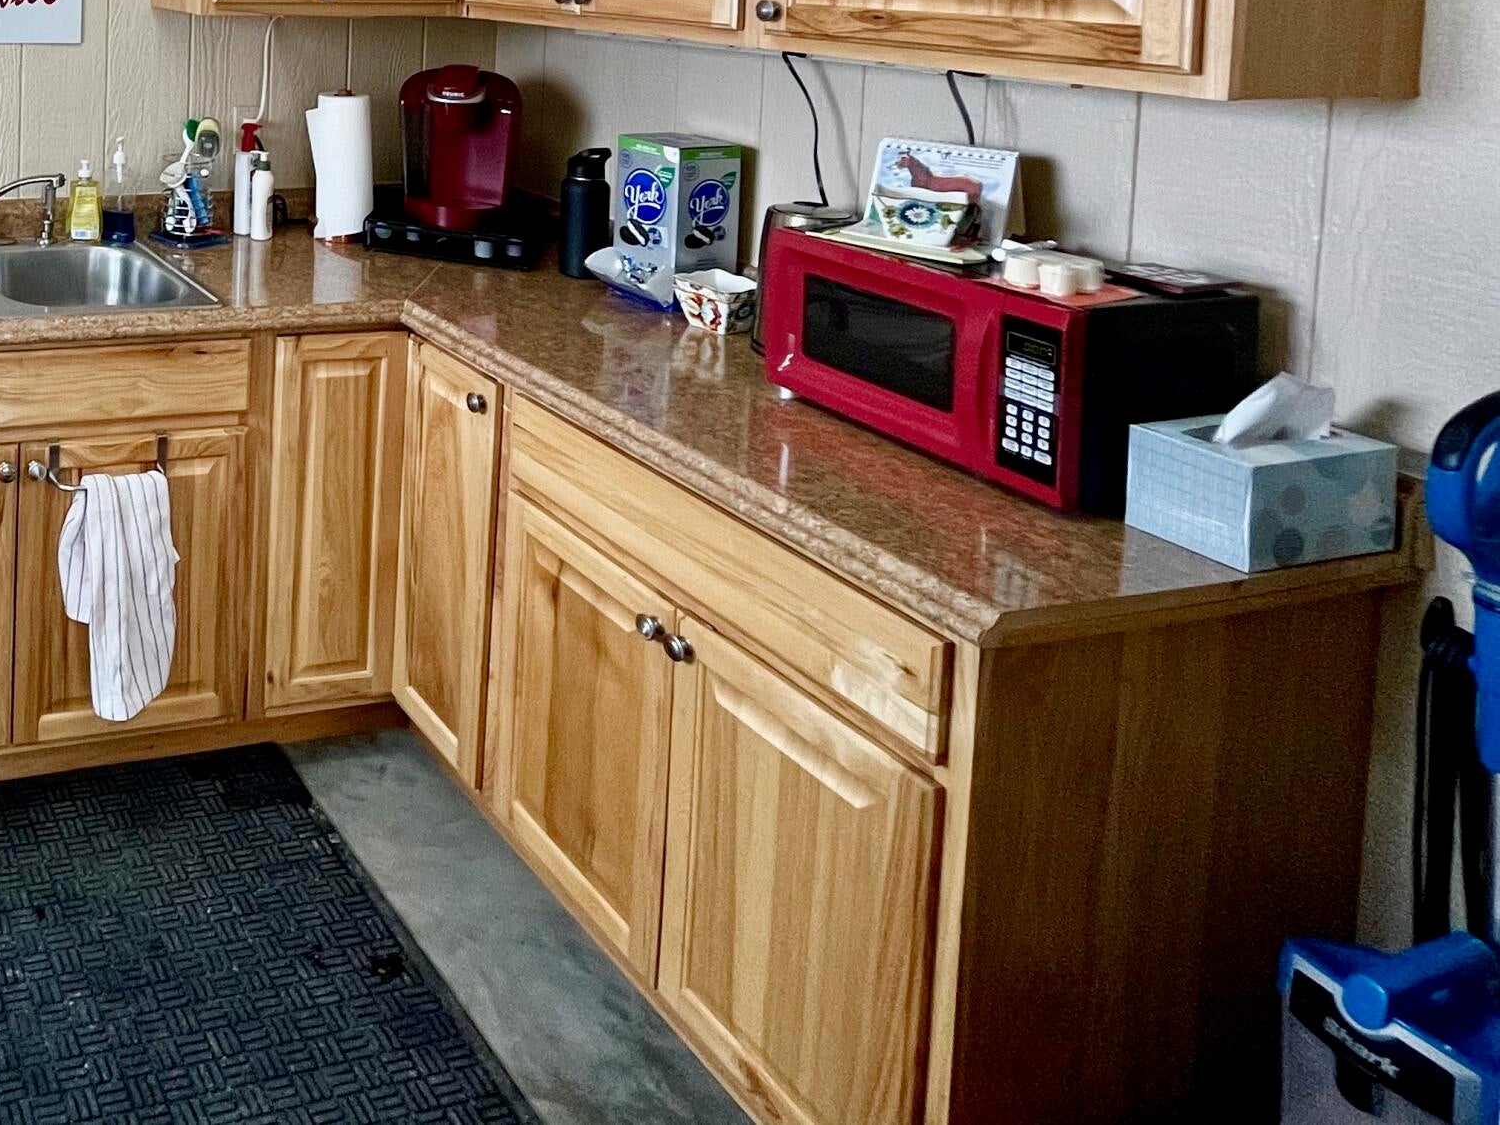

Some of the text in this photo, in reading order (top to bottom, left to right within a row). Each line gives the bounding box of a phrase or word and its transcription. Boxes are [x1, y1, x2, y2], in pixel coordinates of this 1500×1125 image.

[624, 181, 664, 220] York
[690, 187, 728, 226] York
[1322, 1015, 1401, 1079] Shark
